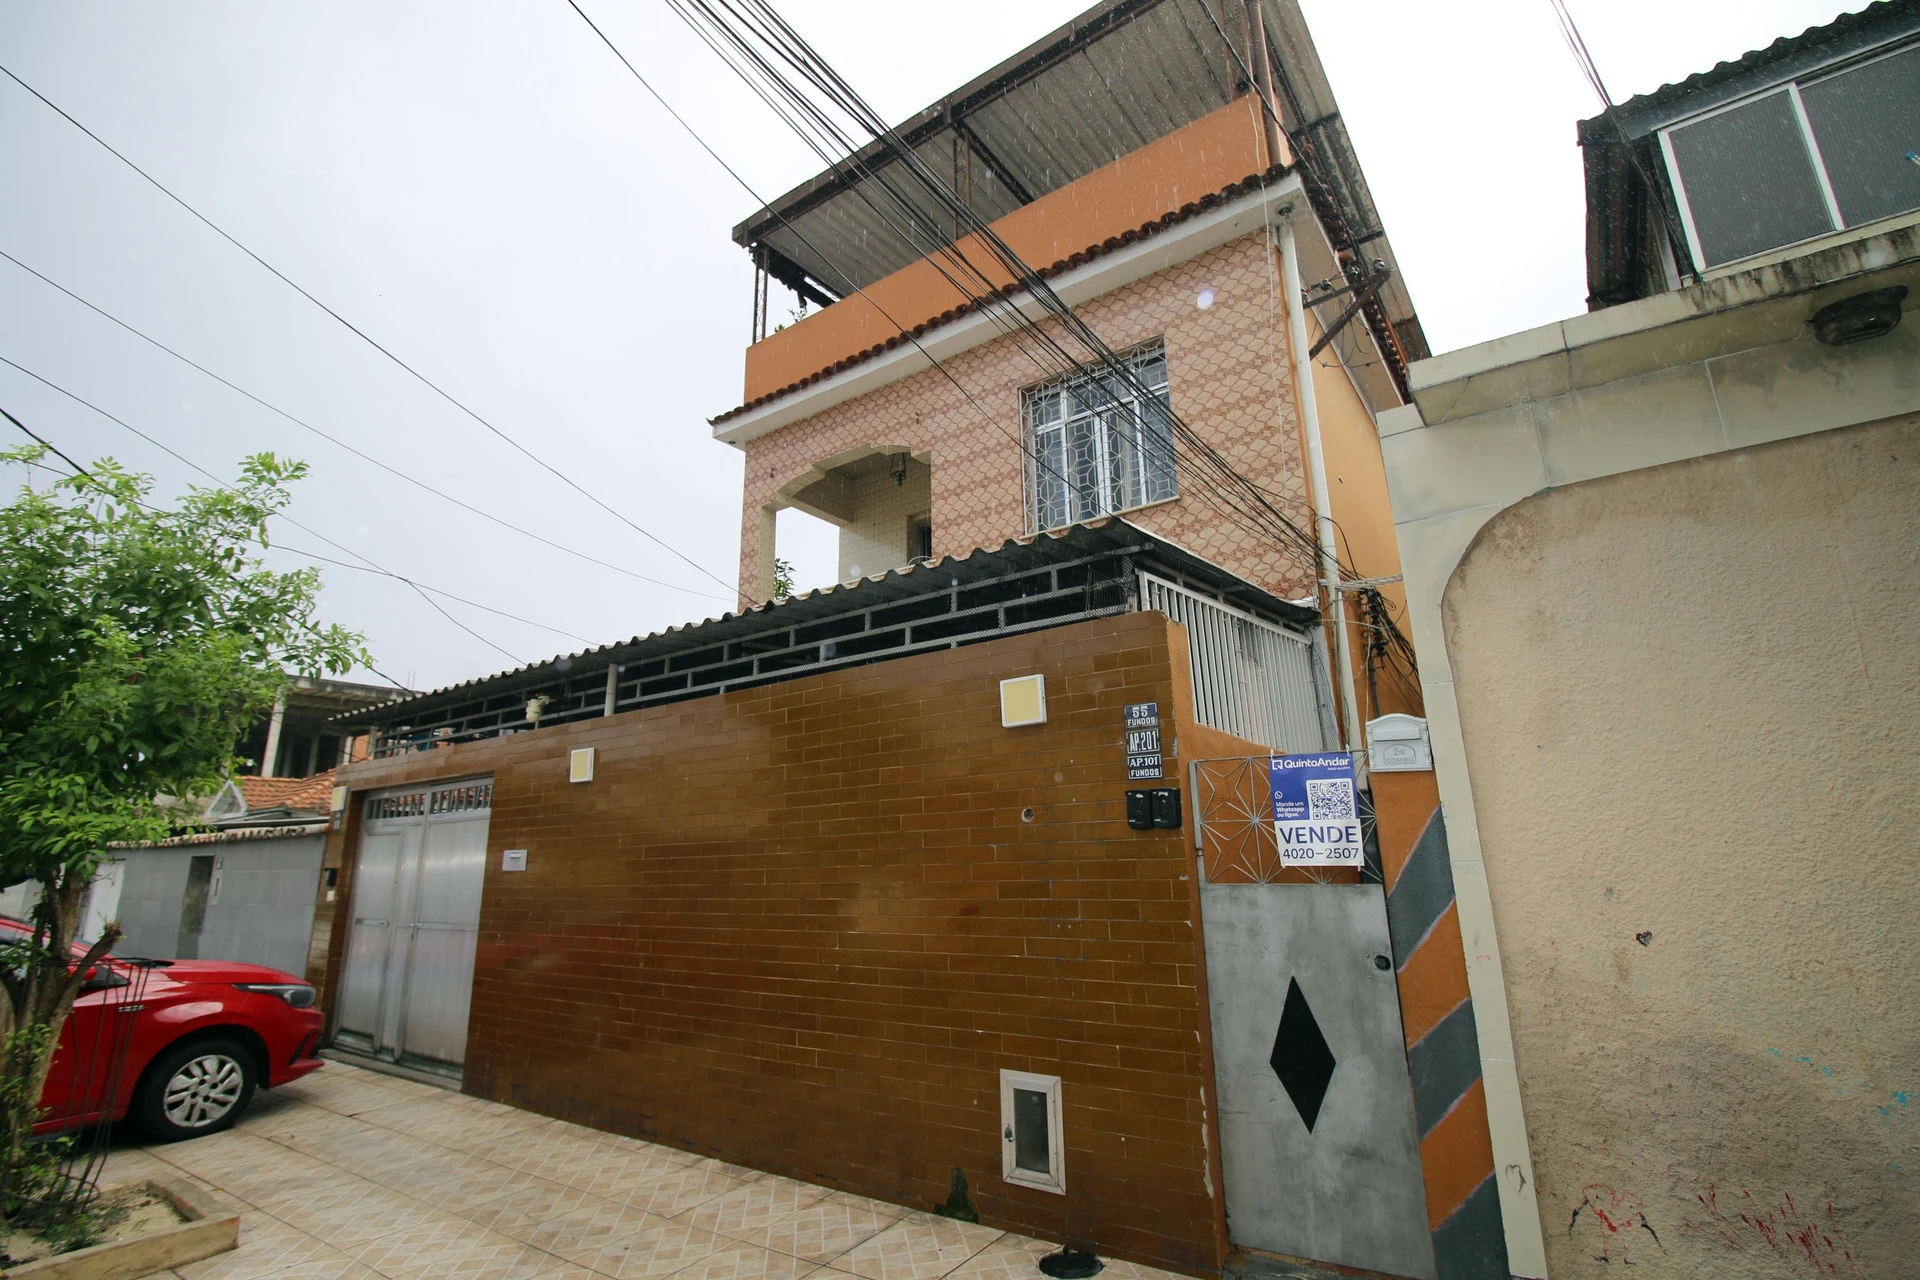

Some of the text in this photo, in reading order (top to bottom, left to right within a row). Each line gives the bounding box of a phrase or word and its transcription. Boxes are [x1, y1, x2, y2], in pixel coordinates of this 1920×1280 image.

[1132, 706, 1148, 718] 55
[1127, 716, 1156, 727] FUNDOS
[1130, 731, 1157, 752] AP.201
[1129, 757, 1158, 767] AP.101
[1283, 757, 1350, 769] QuintoAndar
[1130, 767, 1160, 778] FUNDOS
[1279, 826, 1358, 844] VENDE
[1283, 847, 1359, 859] 4020-2507
